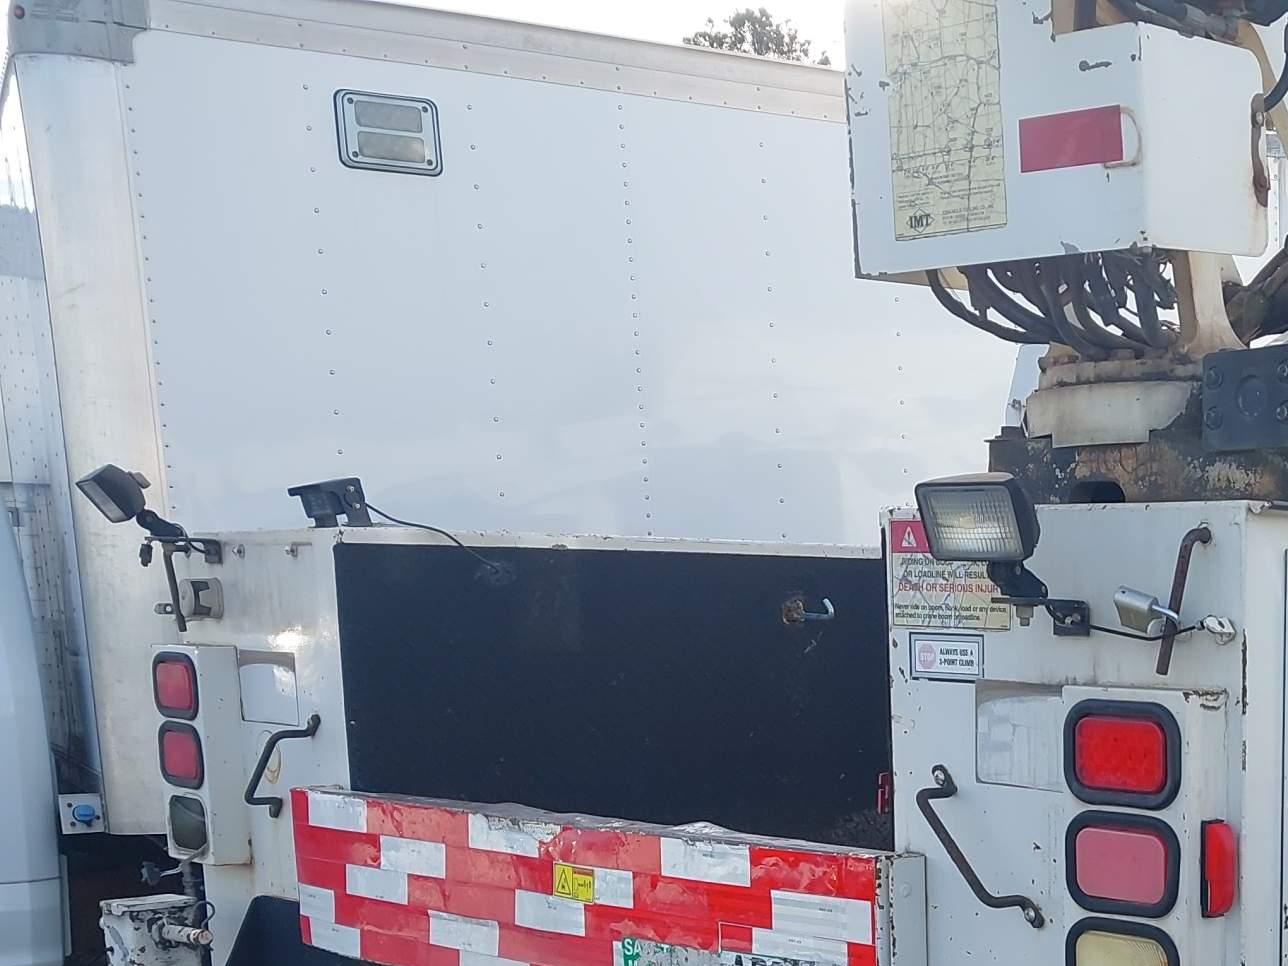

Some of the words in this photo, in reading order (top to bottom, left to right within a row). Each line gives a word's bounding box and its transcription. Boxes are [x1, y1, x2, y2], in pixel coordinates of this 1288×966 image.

[909, 213, 931, 229] IMT
[966, 570, 988, 579] RESUL
[926, 582, 938, 592] OR
[939, 583, 974, 593] SERIOUS
[975, 583, 999, 593] INJUR
[939, 647, 959, 656] ALWAYS
[960, 648, 969, 657] USE
[959, 659, 975, 667] CLIMB
